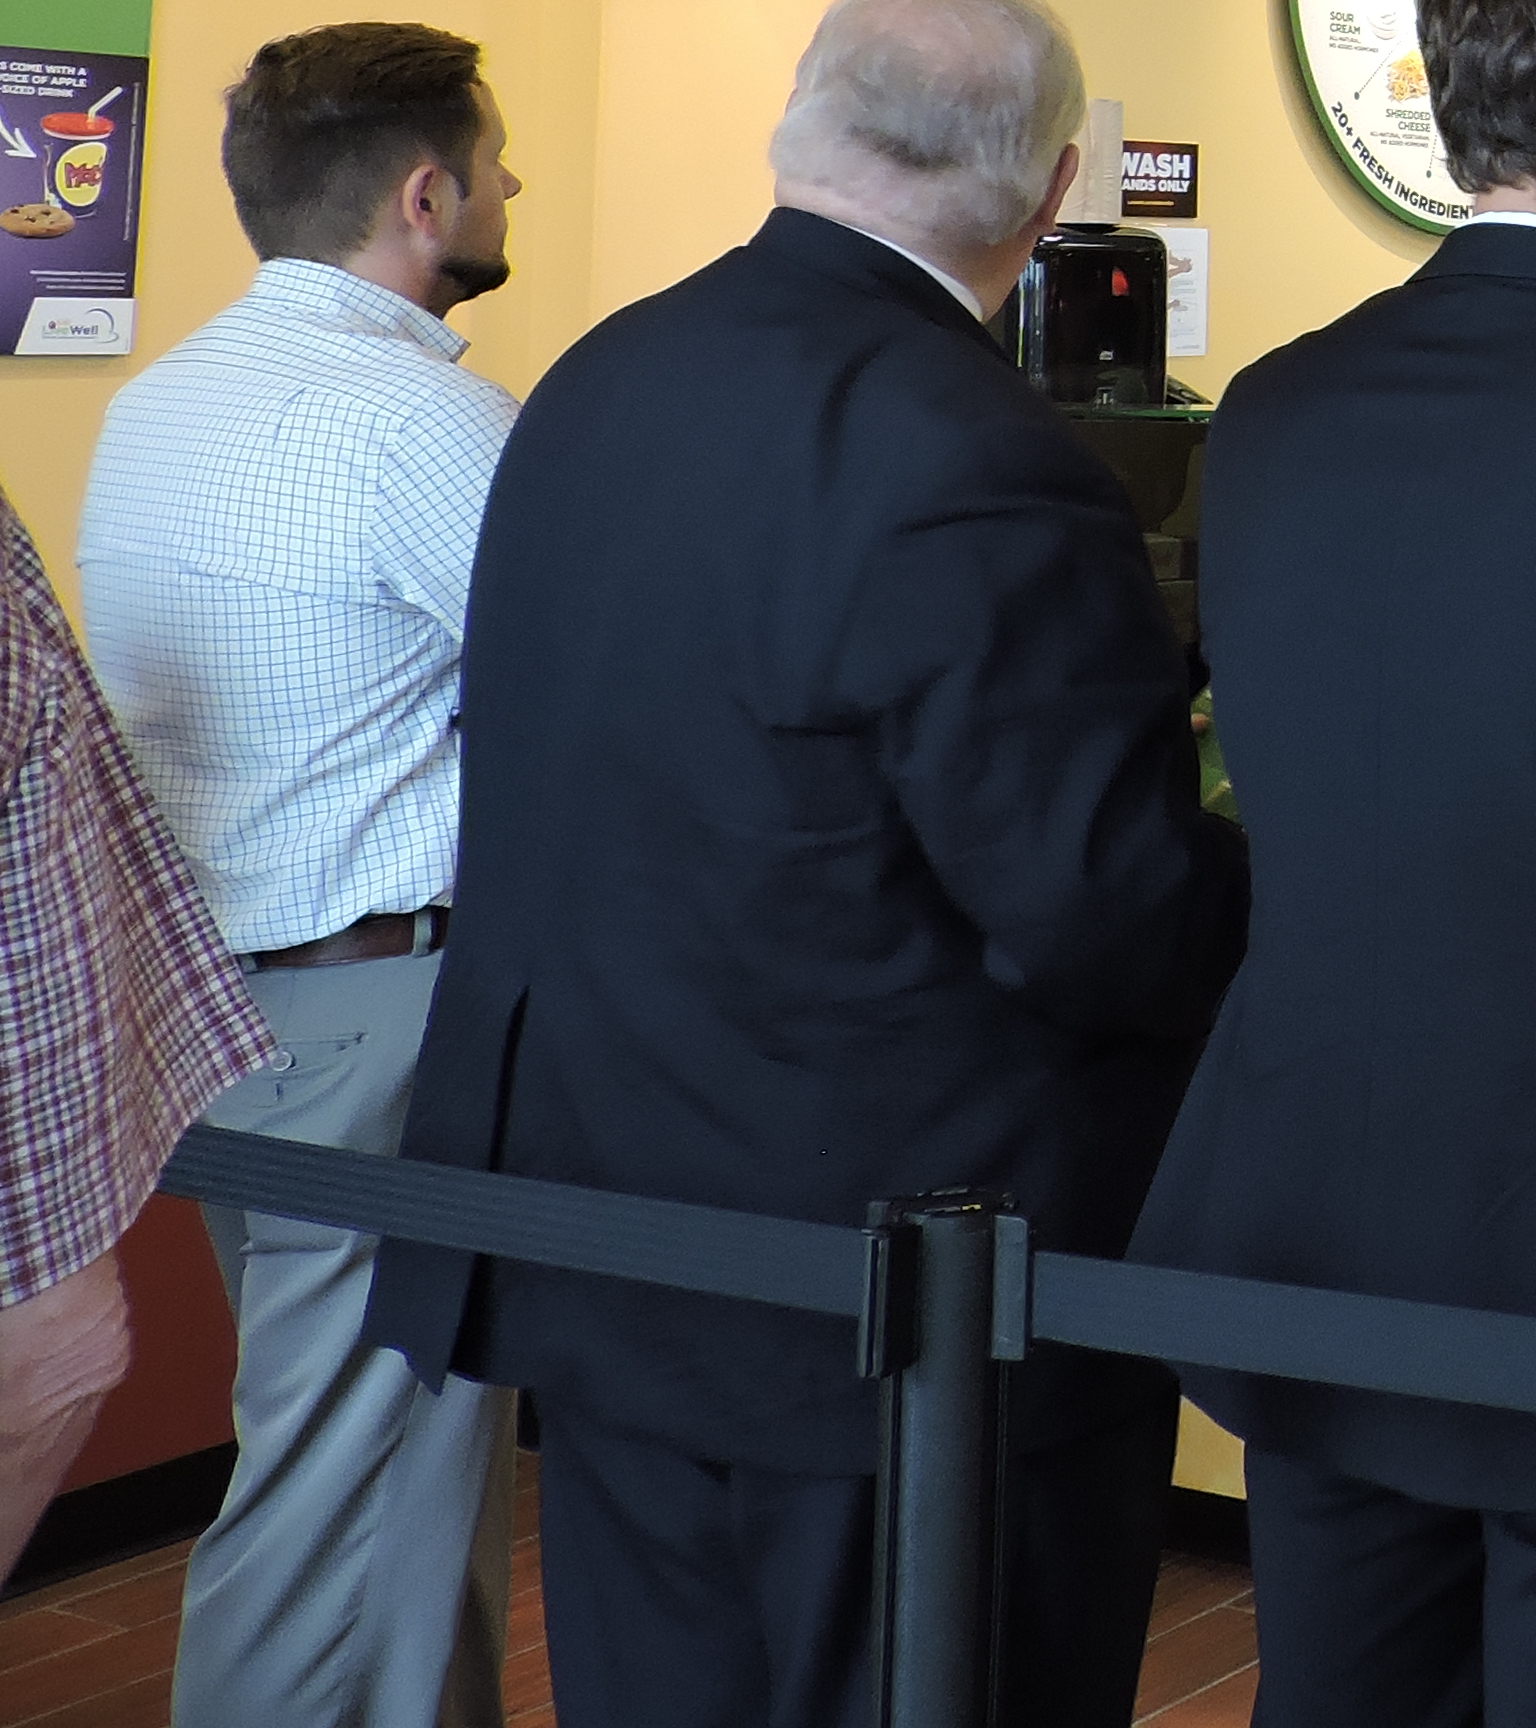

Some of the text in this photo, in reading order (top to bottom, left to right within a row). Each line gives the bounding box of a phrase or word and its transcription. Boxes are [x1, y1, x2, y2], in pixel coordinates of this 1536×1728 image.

[1329, 11, 1355, 23] SOUR
[1329, 23, 1361, 35] CREAM
[45, 65, 76, 75] WITH
[32, 75, 48, 84] OF
[50, 76, 87, 88] APPLE
[1398, 121, 1431, 133] CHEESE
[1352, 136, 1395, 190] FRESH
[1158, 178, 1190, 193] ONLY
